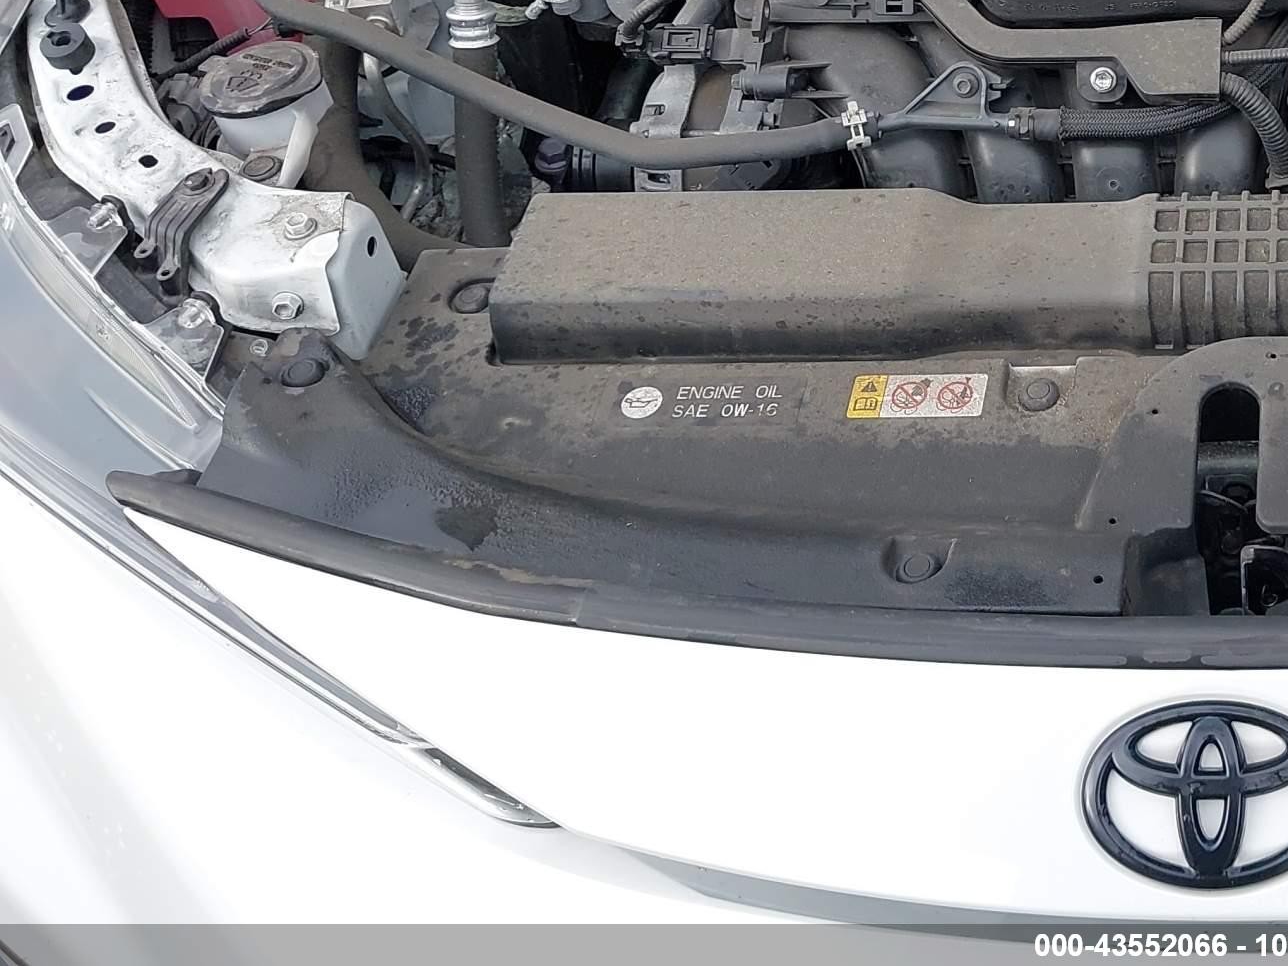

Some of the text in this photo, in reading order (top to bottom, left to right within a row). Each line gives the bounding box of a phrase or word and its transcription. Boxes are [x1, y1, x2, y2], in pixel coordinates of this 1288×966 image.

[676, 384, 783, 400] ENGINE OIL
[671, 403, 779, 418] SAE 0W-16
